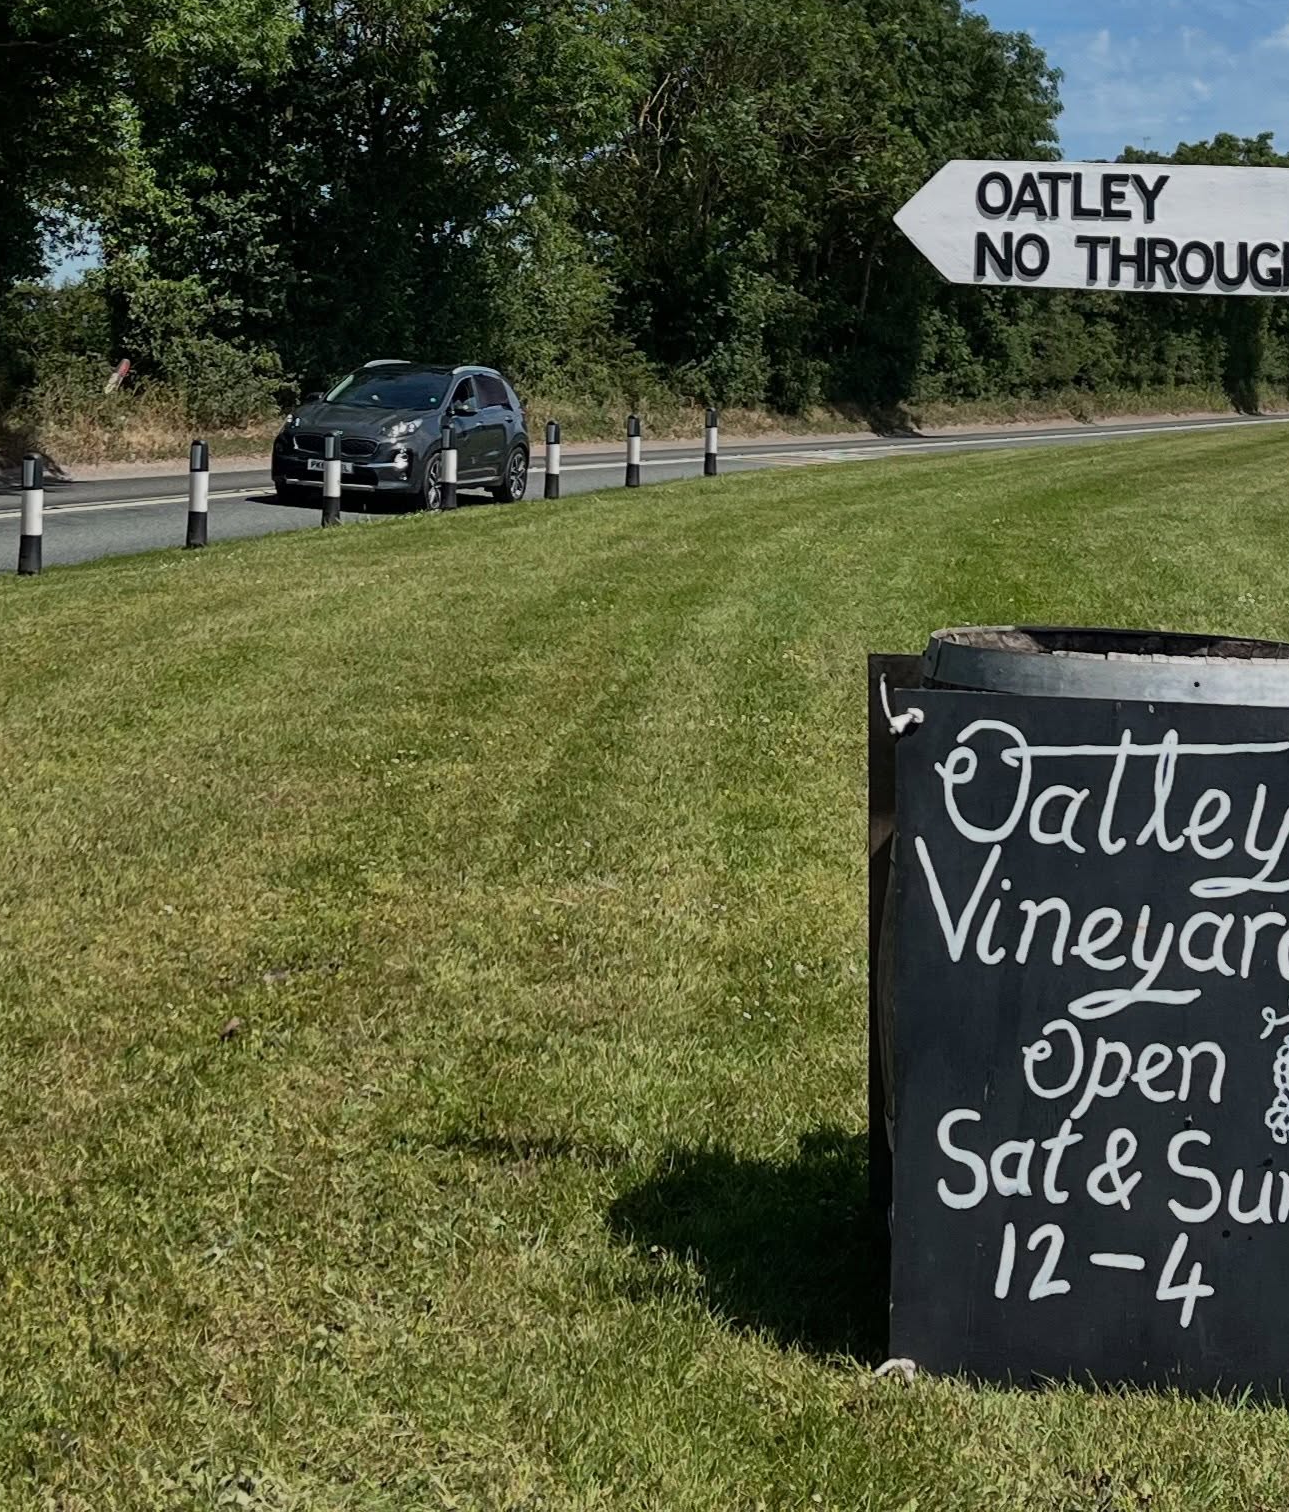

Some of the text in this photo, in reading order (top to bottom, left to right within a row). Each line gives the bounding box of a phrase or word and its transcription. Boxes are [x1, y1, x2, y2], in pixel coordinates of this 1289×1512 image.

[976, 171, 1170, 223] OATLEY
[975, 231, 1049, 282] NO
[1022, 1018, 1225, 1120] Open
[936, 1108, 1083, 1210] Sat
[1086, 1128, 1143, 1210] &
